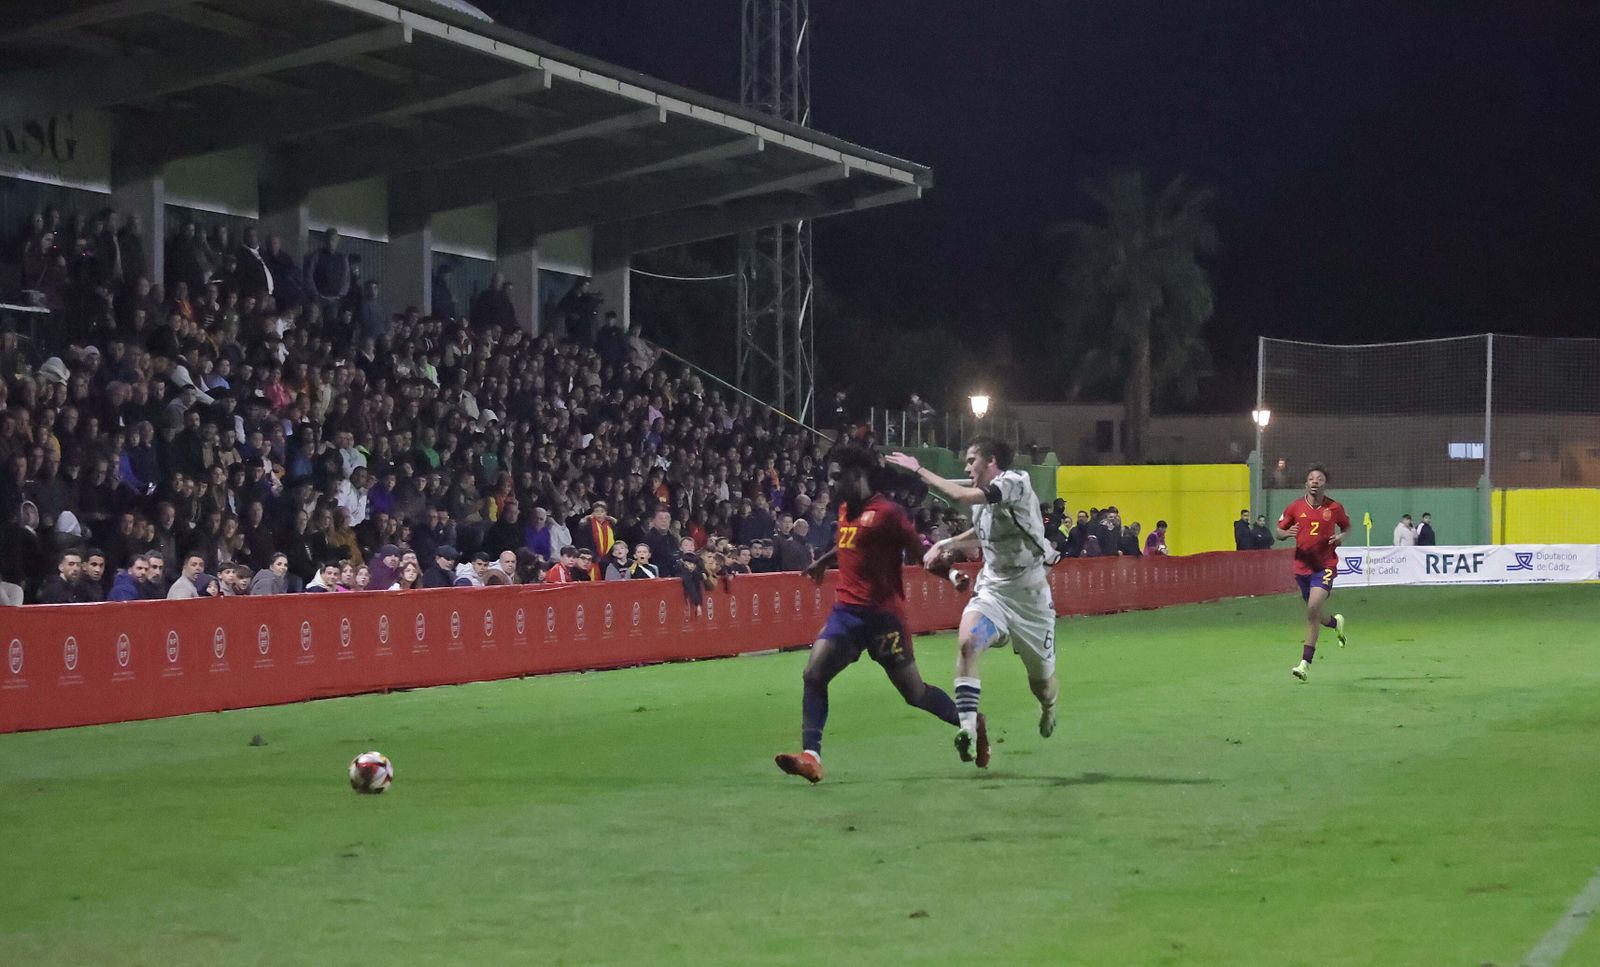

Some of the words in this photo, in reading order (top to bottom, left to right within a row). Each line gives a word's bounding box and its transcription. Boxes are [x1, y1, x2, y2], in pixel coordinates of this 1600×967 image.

[1310, 522, 1320, 536] 2
[839, 527, 857, 548] 22
[1536, 551, 1578, 561] Diputación
[1425, 553, 1485, 575] RFAF
[1537, 563, 1546, 571] de
[1548, 562, 1570, 571] Cádiz
[1323, 568, 1333, 580] 2
[1043, 630, 1052, 649] 6
